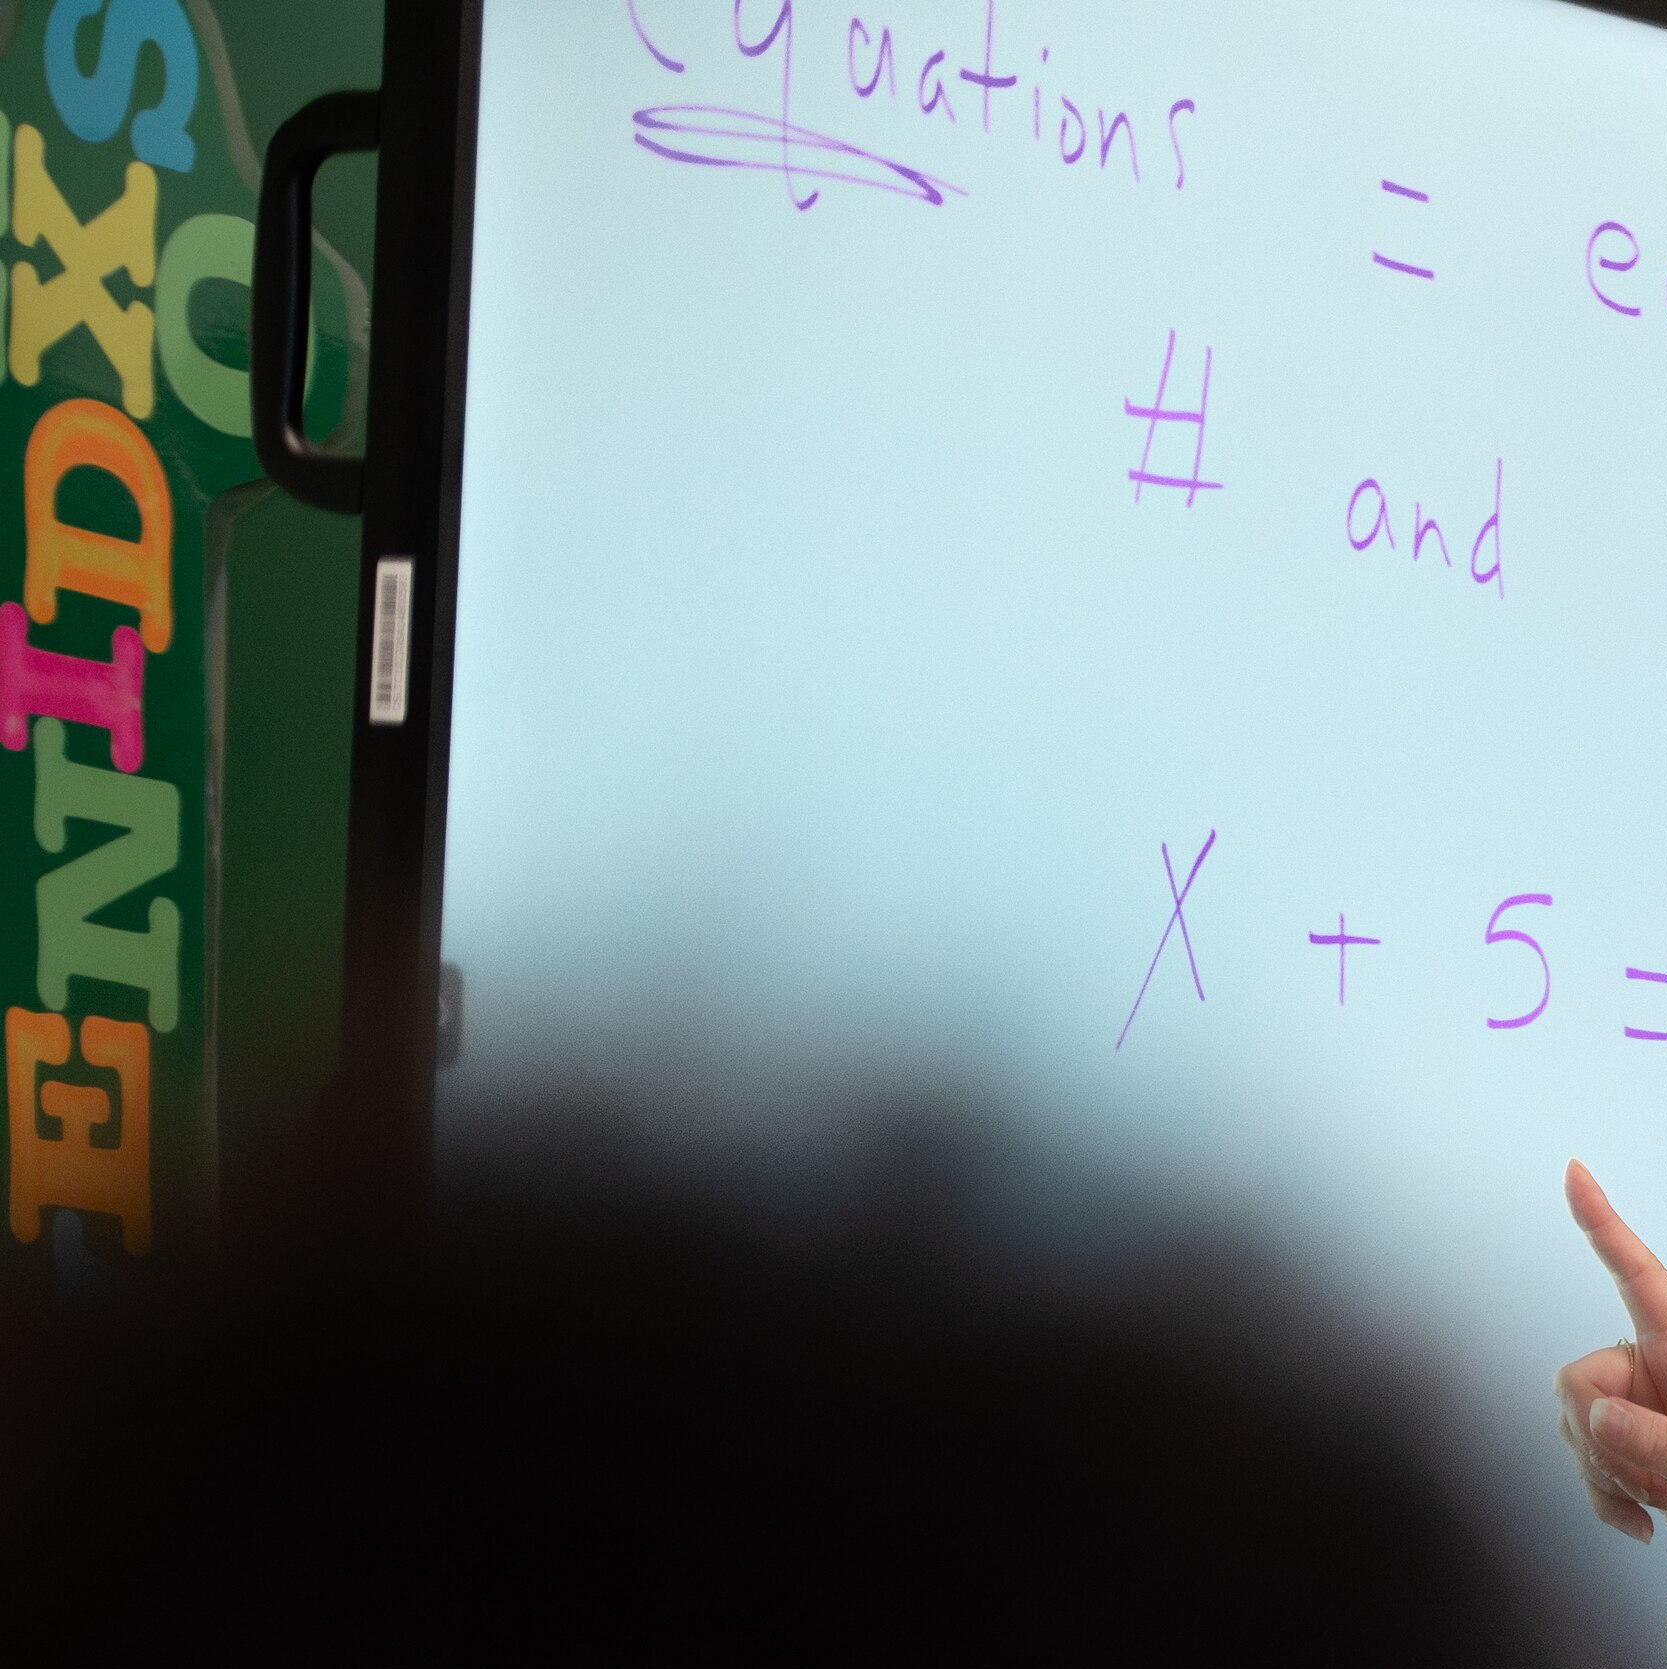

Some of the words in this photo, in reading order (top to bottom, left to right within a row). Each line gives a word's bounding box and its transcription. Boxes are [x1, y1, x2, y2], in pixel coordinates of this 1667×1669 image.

[1123, 328, 1224, 508] #
[1346, 458, 1504, 600] and
[1307, 913, 1382, 1005] +
[1484, 892, 1555, 1030] 5
